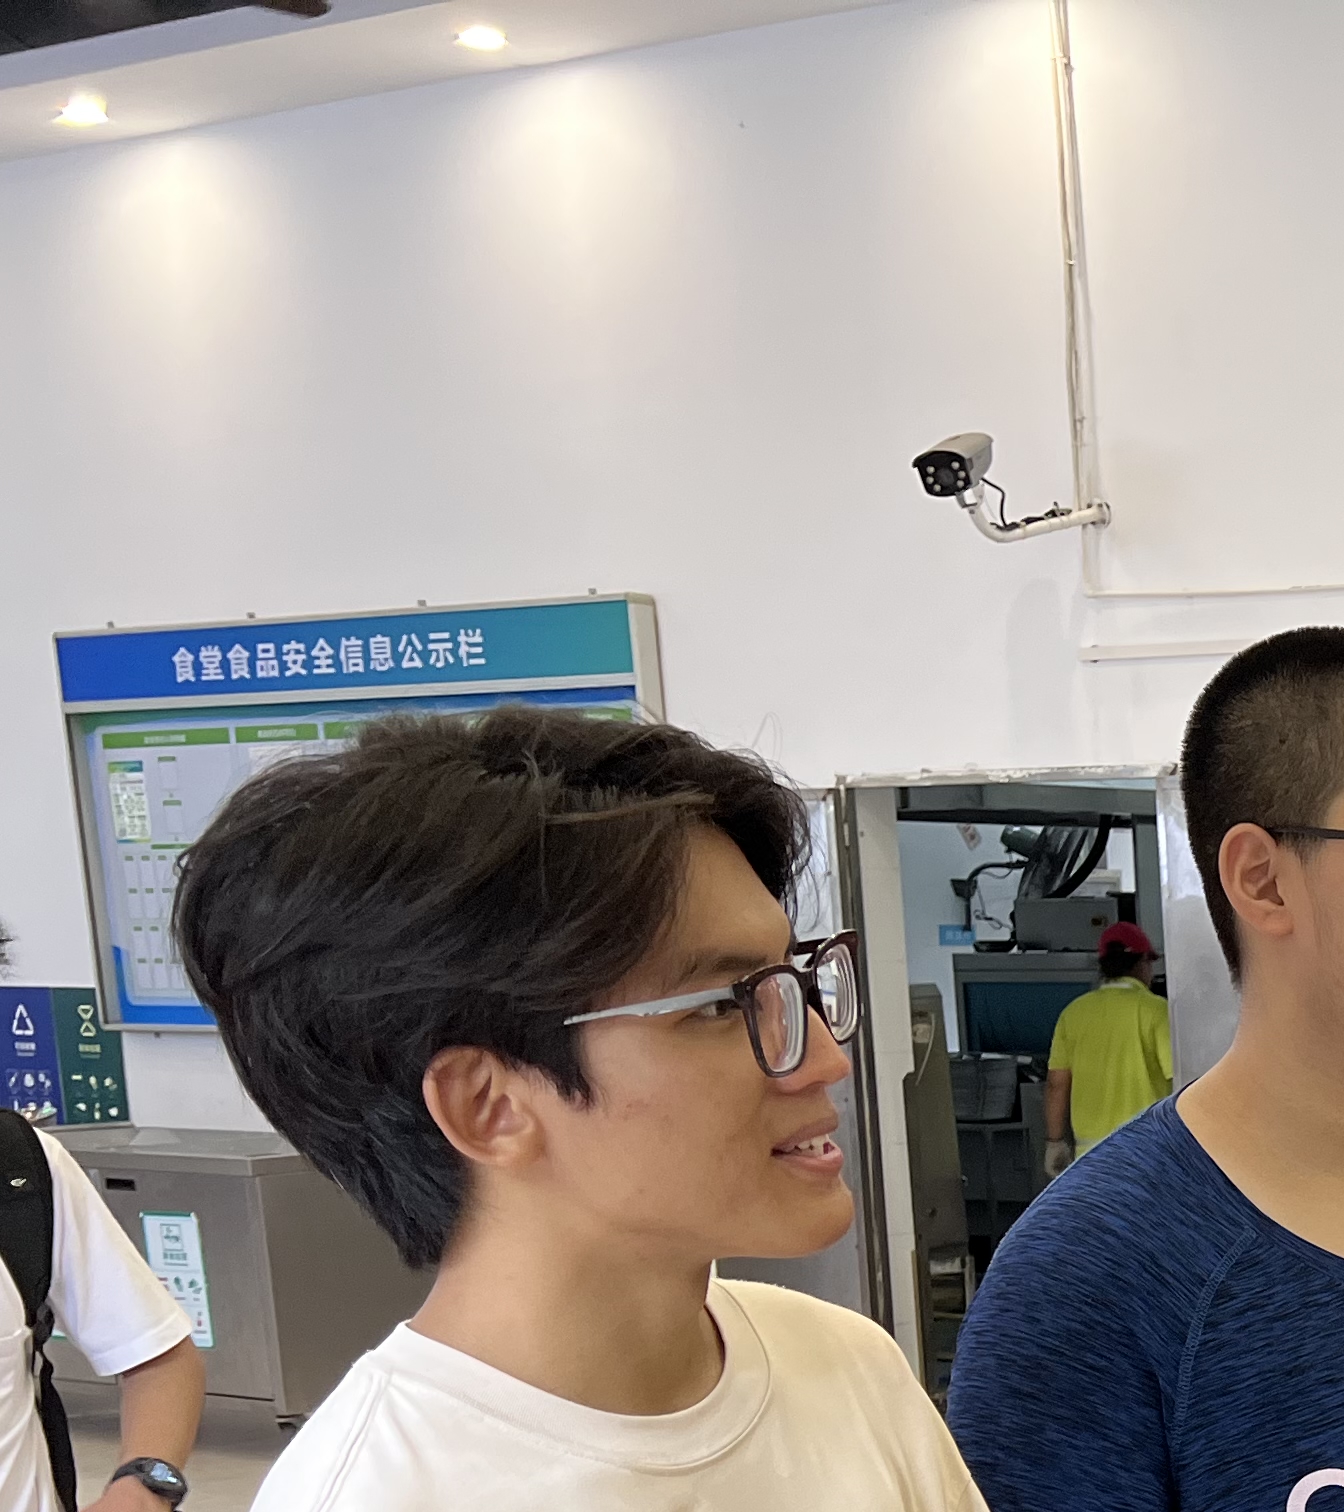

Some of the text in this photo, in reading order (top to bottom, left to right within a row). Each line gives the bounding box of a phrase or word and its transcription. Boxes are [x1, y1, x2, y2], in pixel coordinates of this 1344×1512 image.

[171, 628, 487, 683] 食堂食品安全信息公示栏
